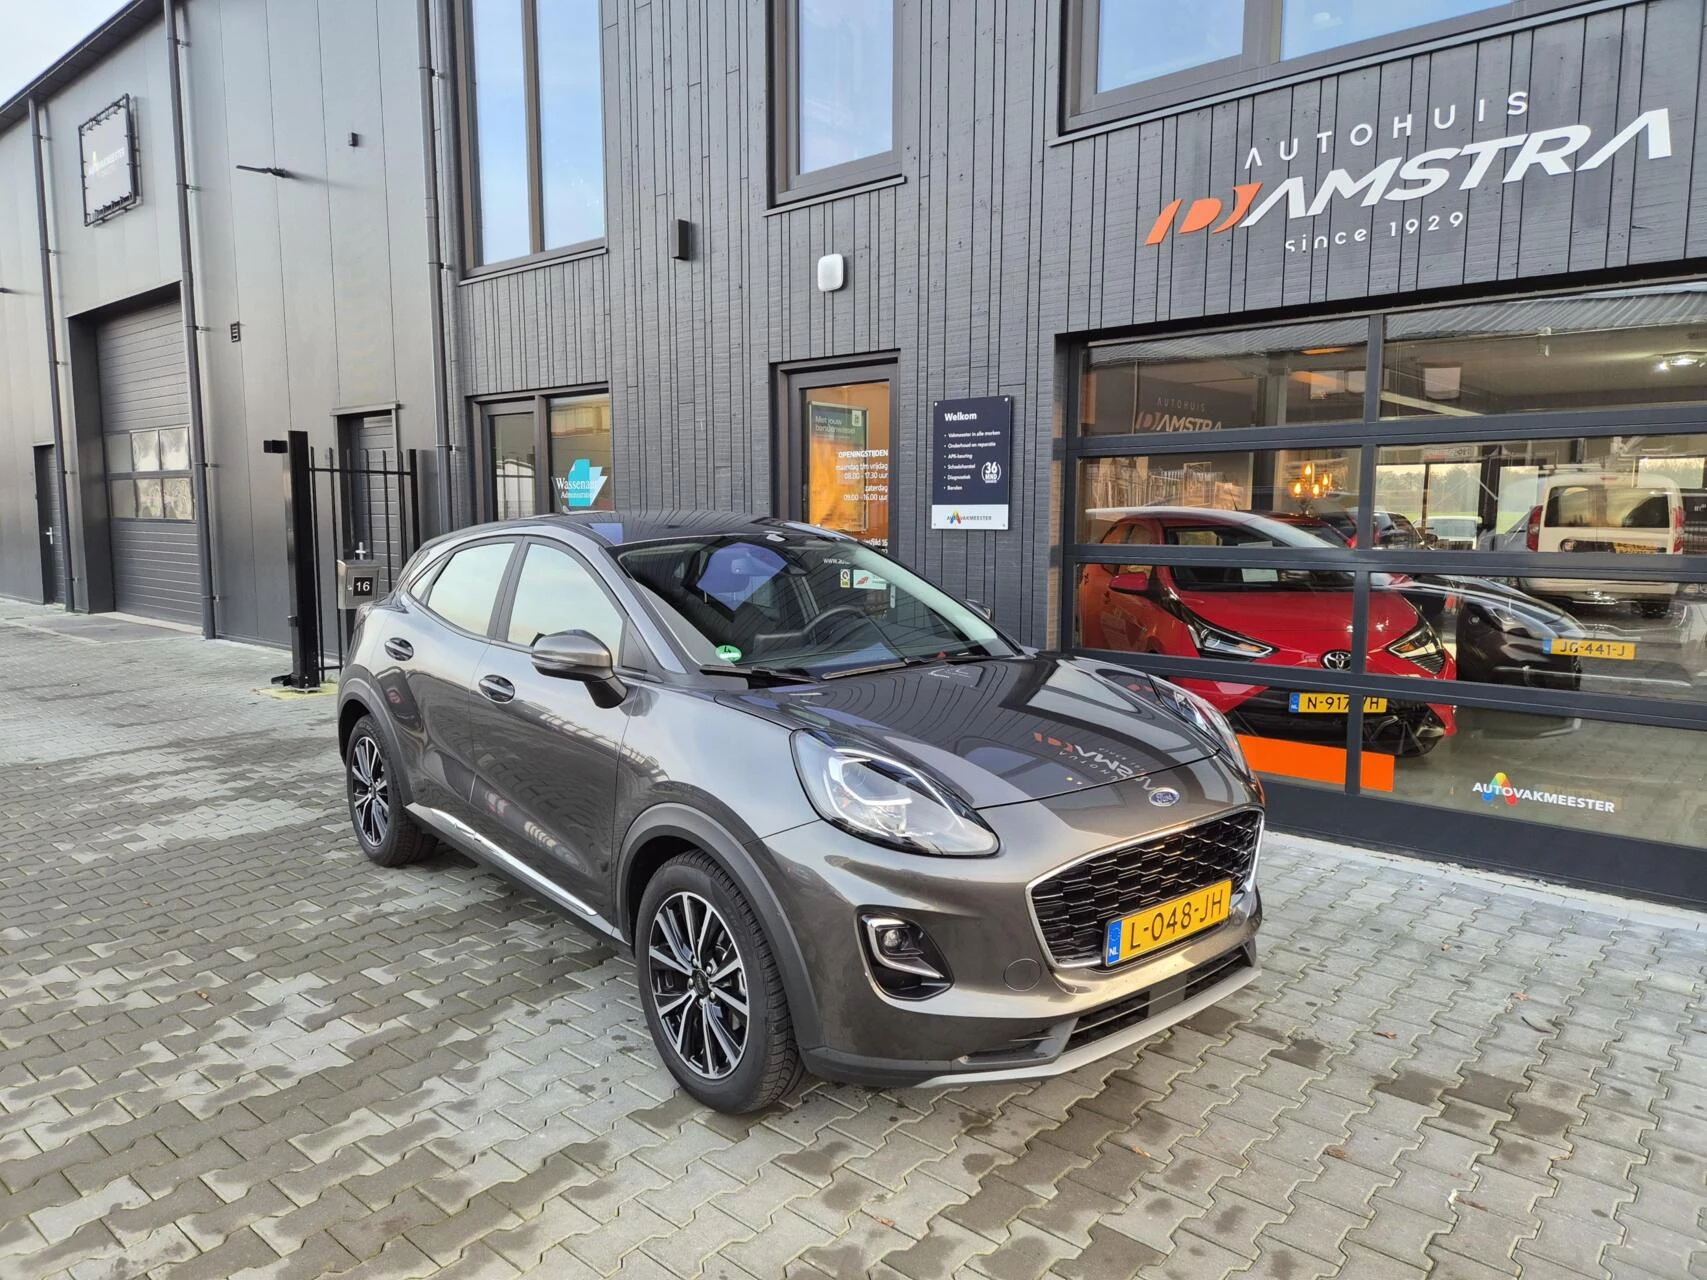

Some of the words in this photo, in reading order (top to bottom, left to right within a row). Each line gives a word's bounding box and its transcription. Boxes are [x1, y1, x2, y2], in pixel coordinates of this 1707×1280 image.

[1244, 91, 1528, 169] AUTOHUIS
[1285, 228, 1368, 252] since
[1389, 211, 1464, 237] 1929
[944, 411, 978, 421] Welkom
[838, 449, 889, 458] OPENINGSTIJDEN
[870, 461, 889, 471] vrijdag
[985, 461, 998, 474] 36
[356, 581, 370, 592] 16
[1560, 643, 1626, 657] JG-441-J
[1307, 696, 1379, 710] N-917H
[1472, 782, 1615, 814] AUTOVAKMEESTER
[1129, 889, 1223, 950] L-048-JH
[1109, 946, 1119, 956] NL
